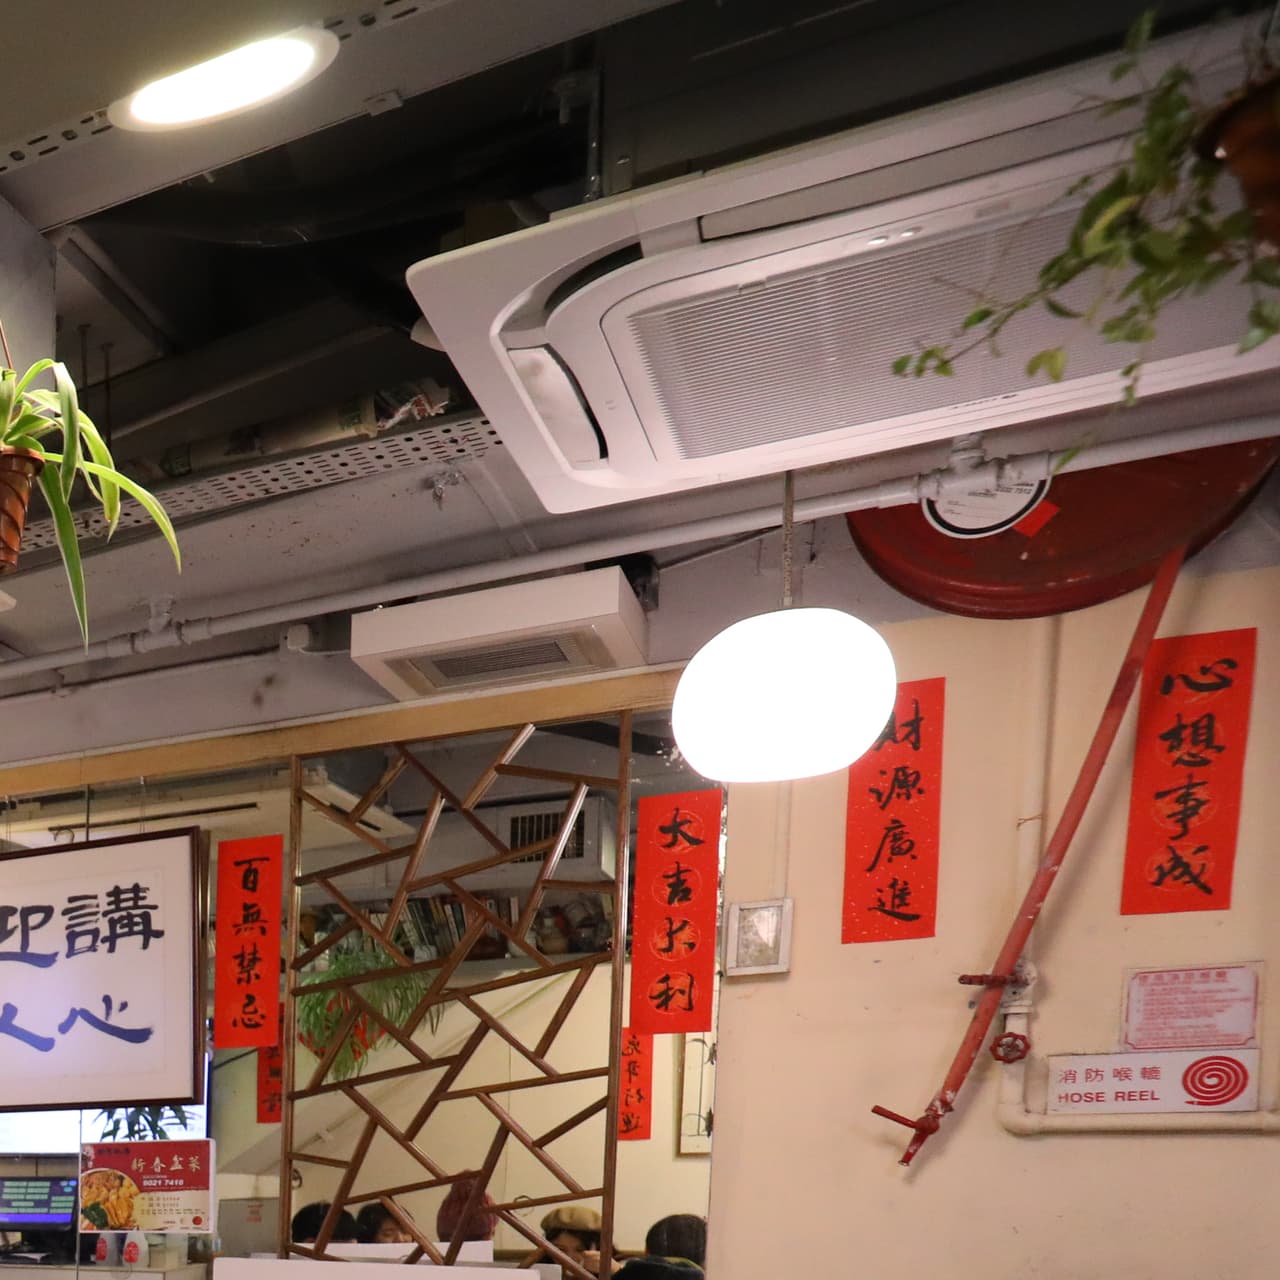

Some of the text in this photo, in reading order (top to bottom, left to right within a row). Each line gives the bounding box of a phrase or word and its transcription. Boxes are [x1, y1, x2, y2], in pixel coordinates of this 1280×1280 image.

[867, 698, 925, 922] 財源廣進
[1151, 658, 1238, 895] 心想事成
[232, 857, 270, 1030] 百無禁忌
[648, 807, 704, 1012] 大吉大利
[1058, 1090, 1160, 1103] HOSE REEL
